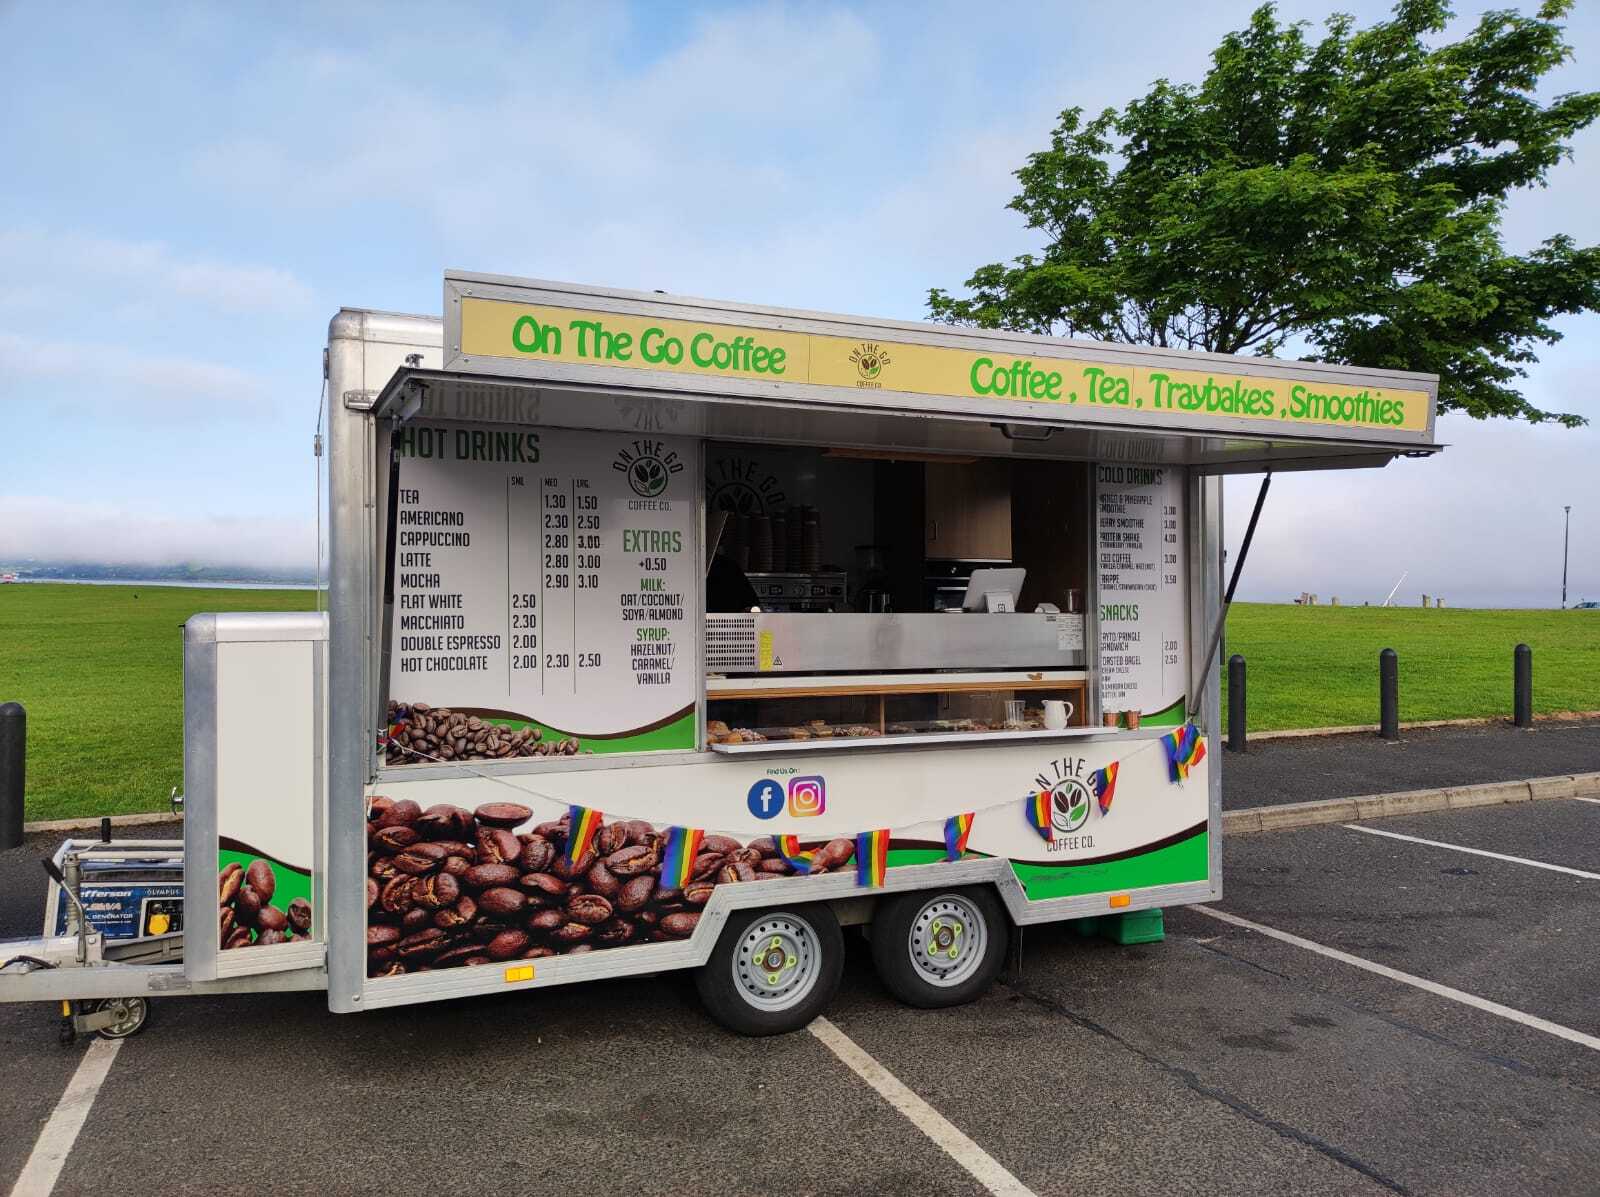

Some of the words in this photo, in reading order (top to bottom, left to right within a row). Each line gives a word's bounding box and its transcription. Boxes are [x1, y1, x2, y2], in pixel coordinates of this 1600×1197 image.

[512, 315, 562, 354] On
[570, 320, 632, 361] The
[640, 327, 683, 366] Go
[691, 333, 786, 375] Coffee
[1289, 385, 1404, 426] Smoothies
[400, 426, 447, 460] HOT
[456, 429, 540, 463] DRINKS
[613, 448, 634, 473] ON
[632, 439, 664, 457] THE
[664, 450, 684, 474] GO
[1127, 467, 1163, 485] DRINKS
[400, 489, 419, 504] TEA
[545, 495, 566, 508] 1.30
[578, 496, 598, 510] 1.50
[628, 500, 657, 511] COFFEE
[400, 510, 464, 526] AMERICANO
[545, 514, 568, 528] 2.30
[578, 515, 600, 529] 2.50
[400, 531, 470, 547] CAPPUCCINO
[545, 535, 568, 548] 2.80
[578, 535, 600, 549] 3.00
[623, 529, 682, 553] EXTRAS
[400, 553, 431, 567] LATTE
[545, 554, 569, 568] 2.80
[578, 555, 600, 568] 3.00
[638, 557, 666, 571] +0.50
[400, 573, 440, 589] MOCHA
[546, 574, 569, 588] 2.90
[578, 574, 599, 588] 3.10
[640, 578, 665, 591] MILK:
[400, 594, 425, 609] FLAT
[428, 594, 462, 609] WHITE
[513, 594, 536, 609] 2.50
[621, 593, 684, 607] OAT/COCONUT/
[622, 608, 683, 621] SOYA/ALMOND
[1100, 605, 1139, 621] SNACKS
[401, 615, 464, 630] MACCHIATO
[513, 615, 536, 628] 2.30
[637, 628, 670, 641] SYRUP:
[401, 636, 443, 651] DOUBLE
[447, 635, 500, 649] ESPRESSO
[513, 635, 536, 648] 2.00
[631, 643, 675, 656] HAZELNUT/
[401, 658, 422, 672] HOT
[426, 656, 488, 671] CHOCOLATE
[513, 655, 536, 669] 2.00
[546, 654, 569, 668] 2.30
[579, 654, 600, 667] 2.50
[632, 657, 674, 671] CARAMEL/
[637, 672, 671, 685] VANILLA
[1051, 757, 1085, 779] THE
[1047, 836, 1079, 852] COFFEE
